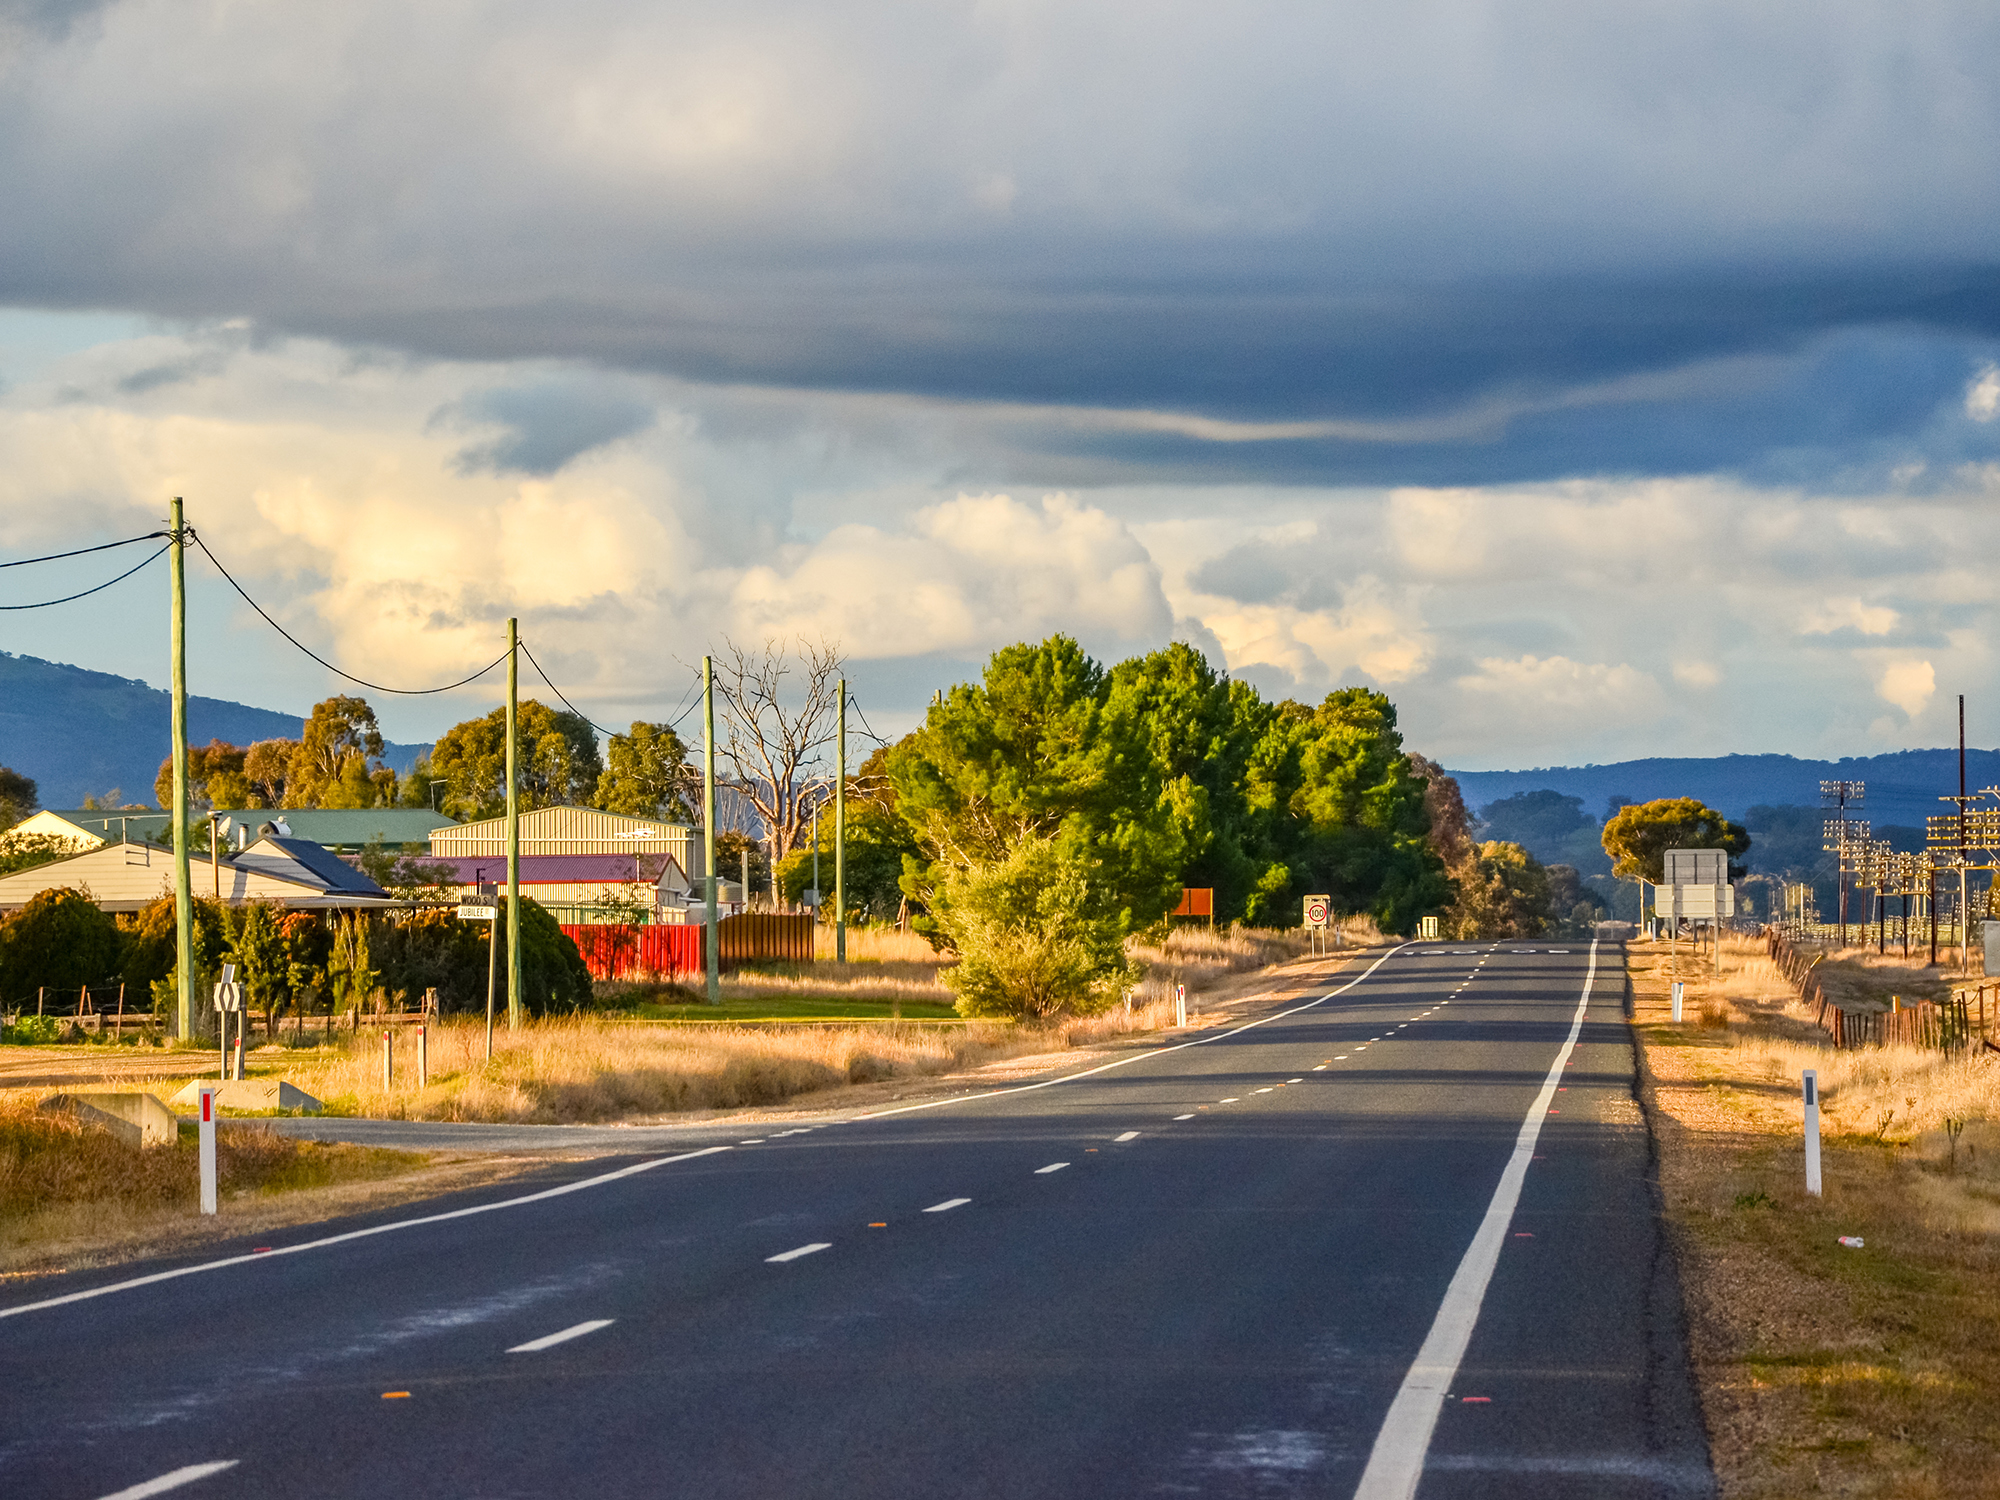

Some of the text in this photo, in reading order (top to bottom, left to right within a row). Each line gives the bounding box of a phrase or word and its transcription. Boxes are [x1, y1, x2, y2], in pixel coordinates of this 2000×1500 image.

[461, 896, 481, 905] WOOD
[460, 908, 484, 917] JUBILEE
[1312, 909, 1324, 917] 100
